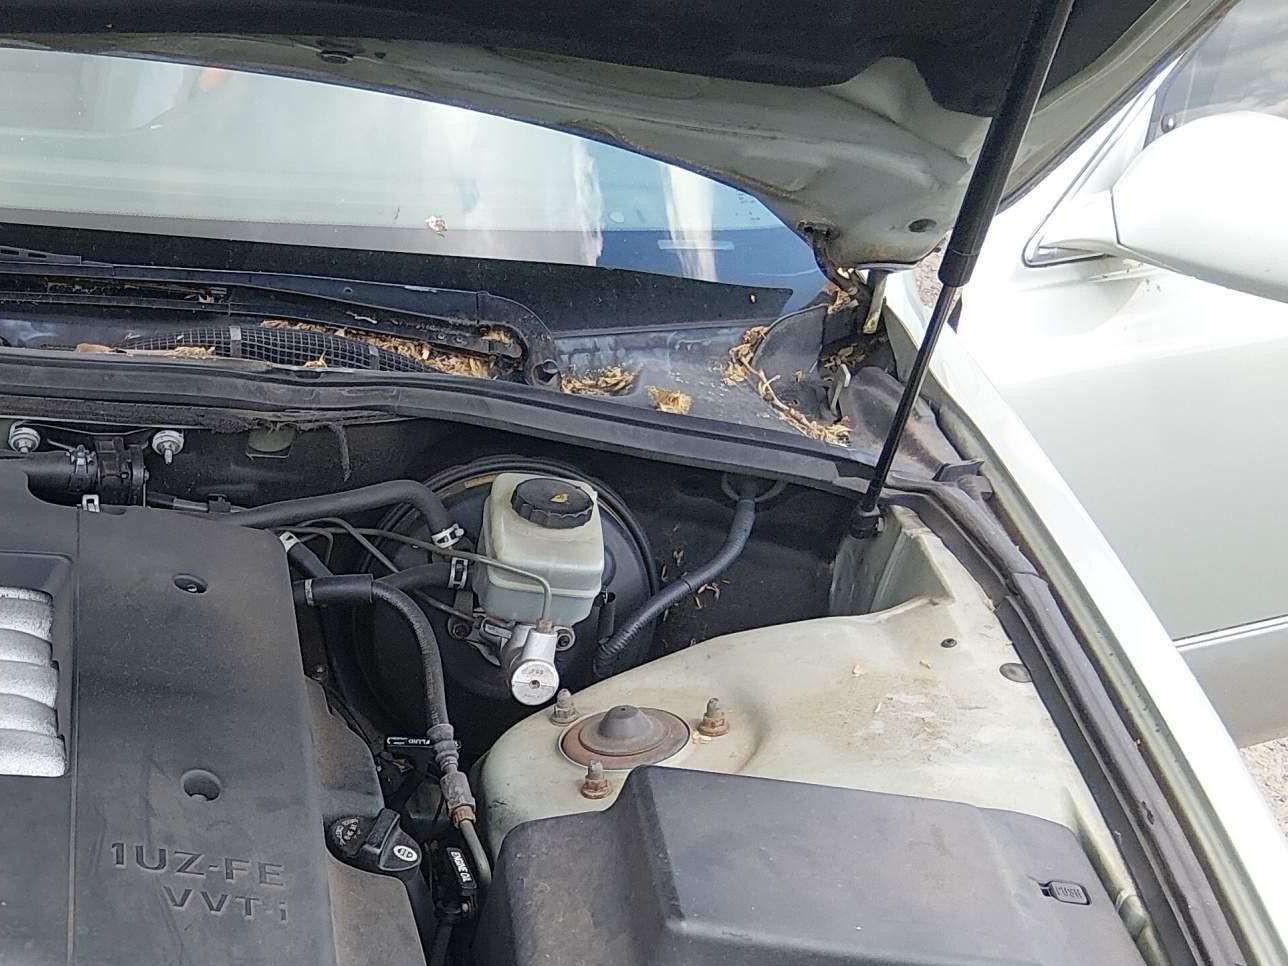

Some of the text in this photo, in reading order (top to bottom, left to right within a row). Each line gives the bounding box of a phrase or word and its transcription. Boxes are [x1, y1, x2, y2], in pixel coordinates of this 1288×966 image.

[407, 737, 430, 745] FLUID
[110, 841, 285, 888] 1UZ-FE
[450, 850, 473, 883] ENGINE OIL
[162, 885, 289, 923] VVT-i
[1054, 886, 1083, 898] PUSH
